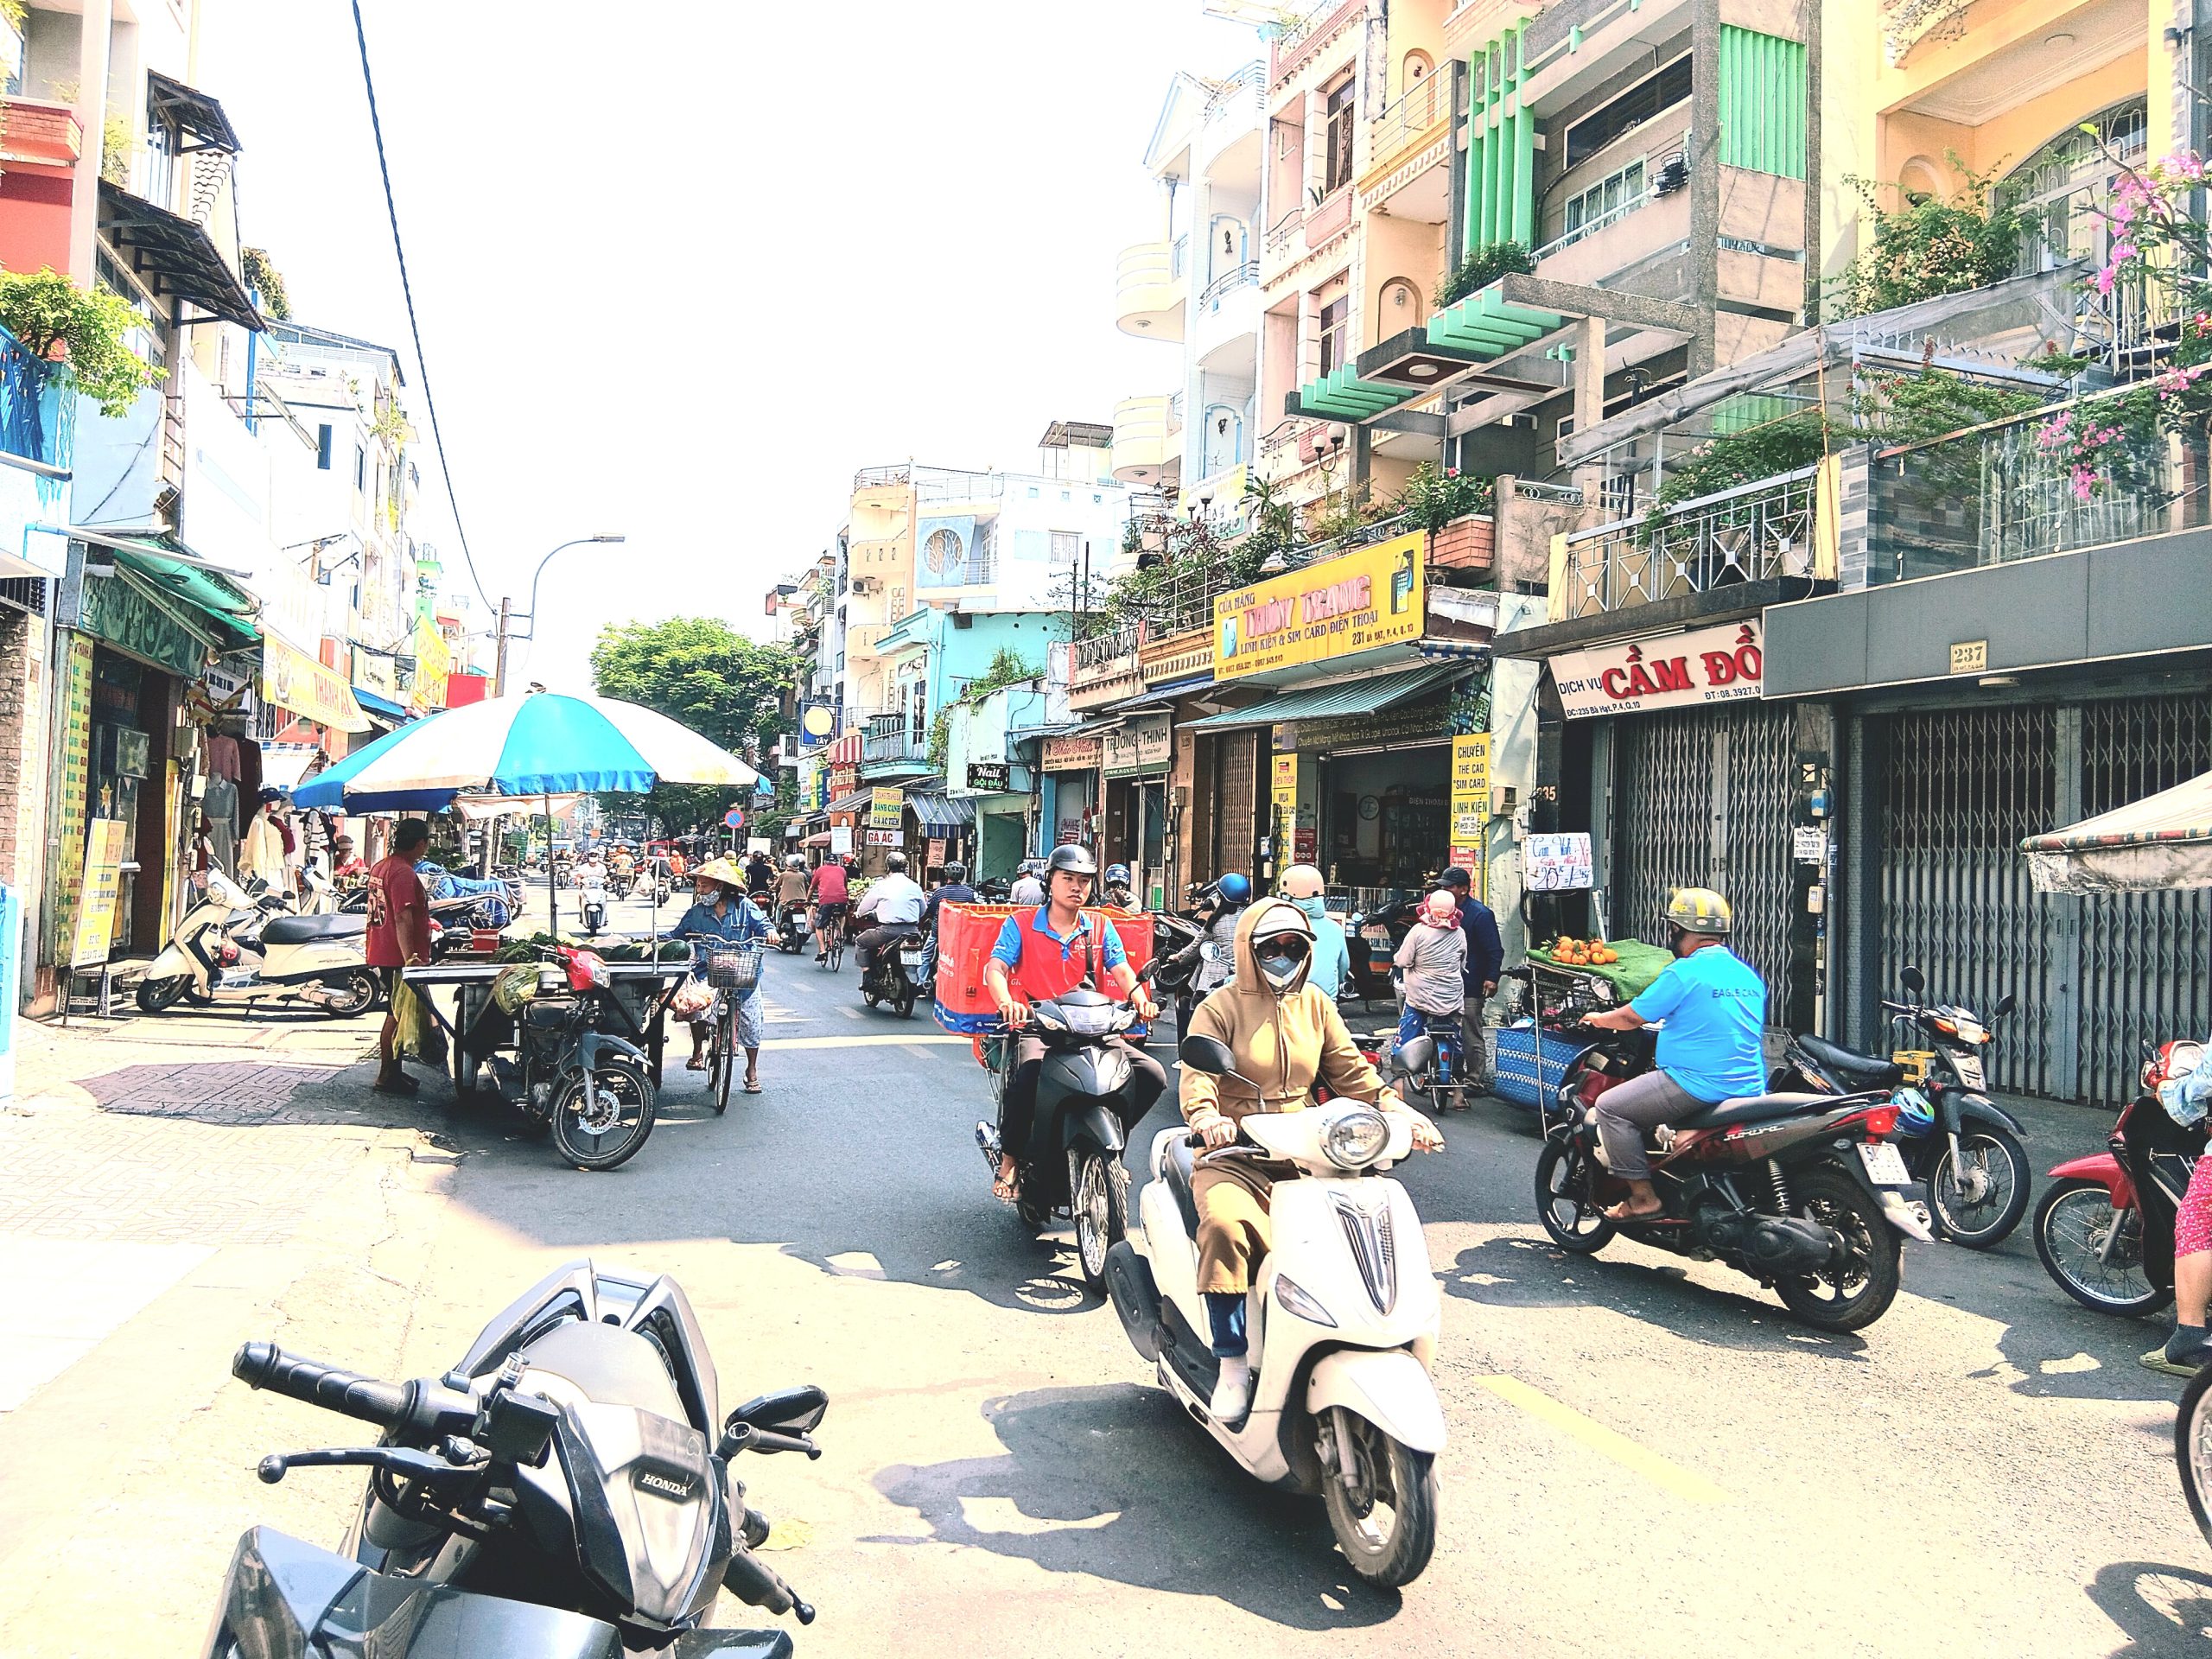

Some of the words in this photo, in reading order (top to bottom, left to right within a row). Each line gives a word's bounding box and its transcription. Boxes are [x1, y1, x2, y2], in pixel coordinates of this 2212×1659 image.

[1300, 575, 1371, 624] TRANG
[1241, 638, 1258, 655] LINH
[1260, 634, 1277, 652] KIỆN
[1287, 631, 1301, 644] SIM
[1305, 625, 1327, 639] CARD
[1330, 615, 1349, 635] ĐIỆN
[1352, 610, 1379, 628] THOẠI
[1352, 631, 1364, 645] 231
[1602, 644, 1694, 699] CẦM
[1700, 624, 1761, 685] ĐỒ
[1954, 645, 1983, 664] 237
[1558, 677, 1585, 696] DỊCH
[1586, 677, 1603, 692] VỤ
[1142, 728, 1167, 747] THỊNH
[1458, 742, 1485, 759] CHUYÊN
[976, 767, 1001, 778] Nail
[1471, 761, 1484, 773] CÀO
[1469, 778, 1485, 789] CARD
[1453, 802, 1468, 814] LINH
[868, 830, 879, 842] GÀ
[882, 830, 893, 842] ÁC
[641, 1473, 687, 1497] HONDA
